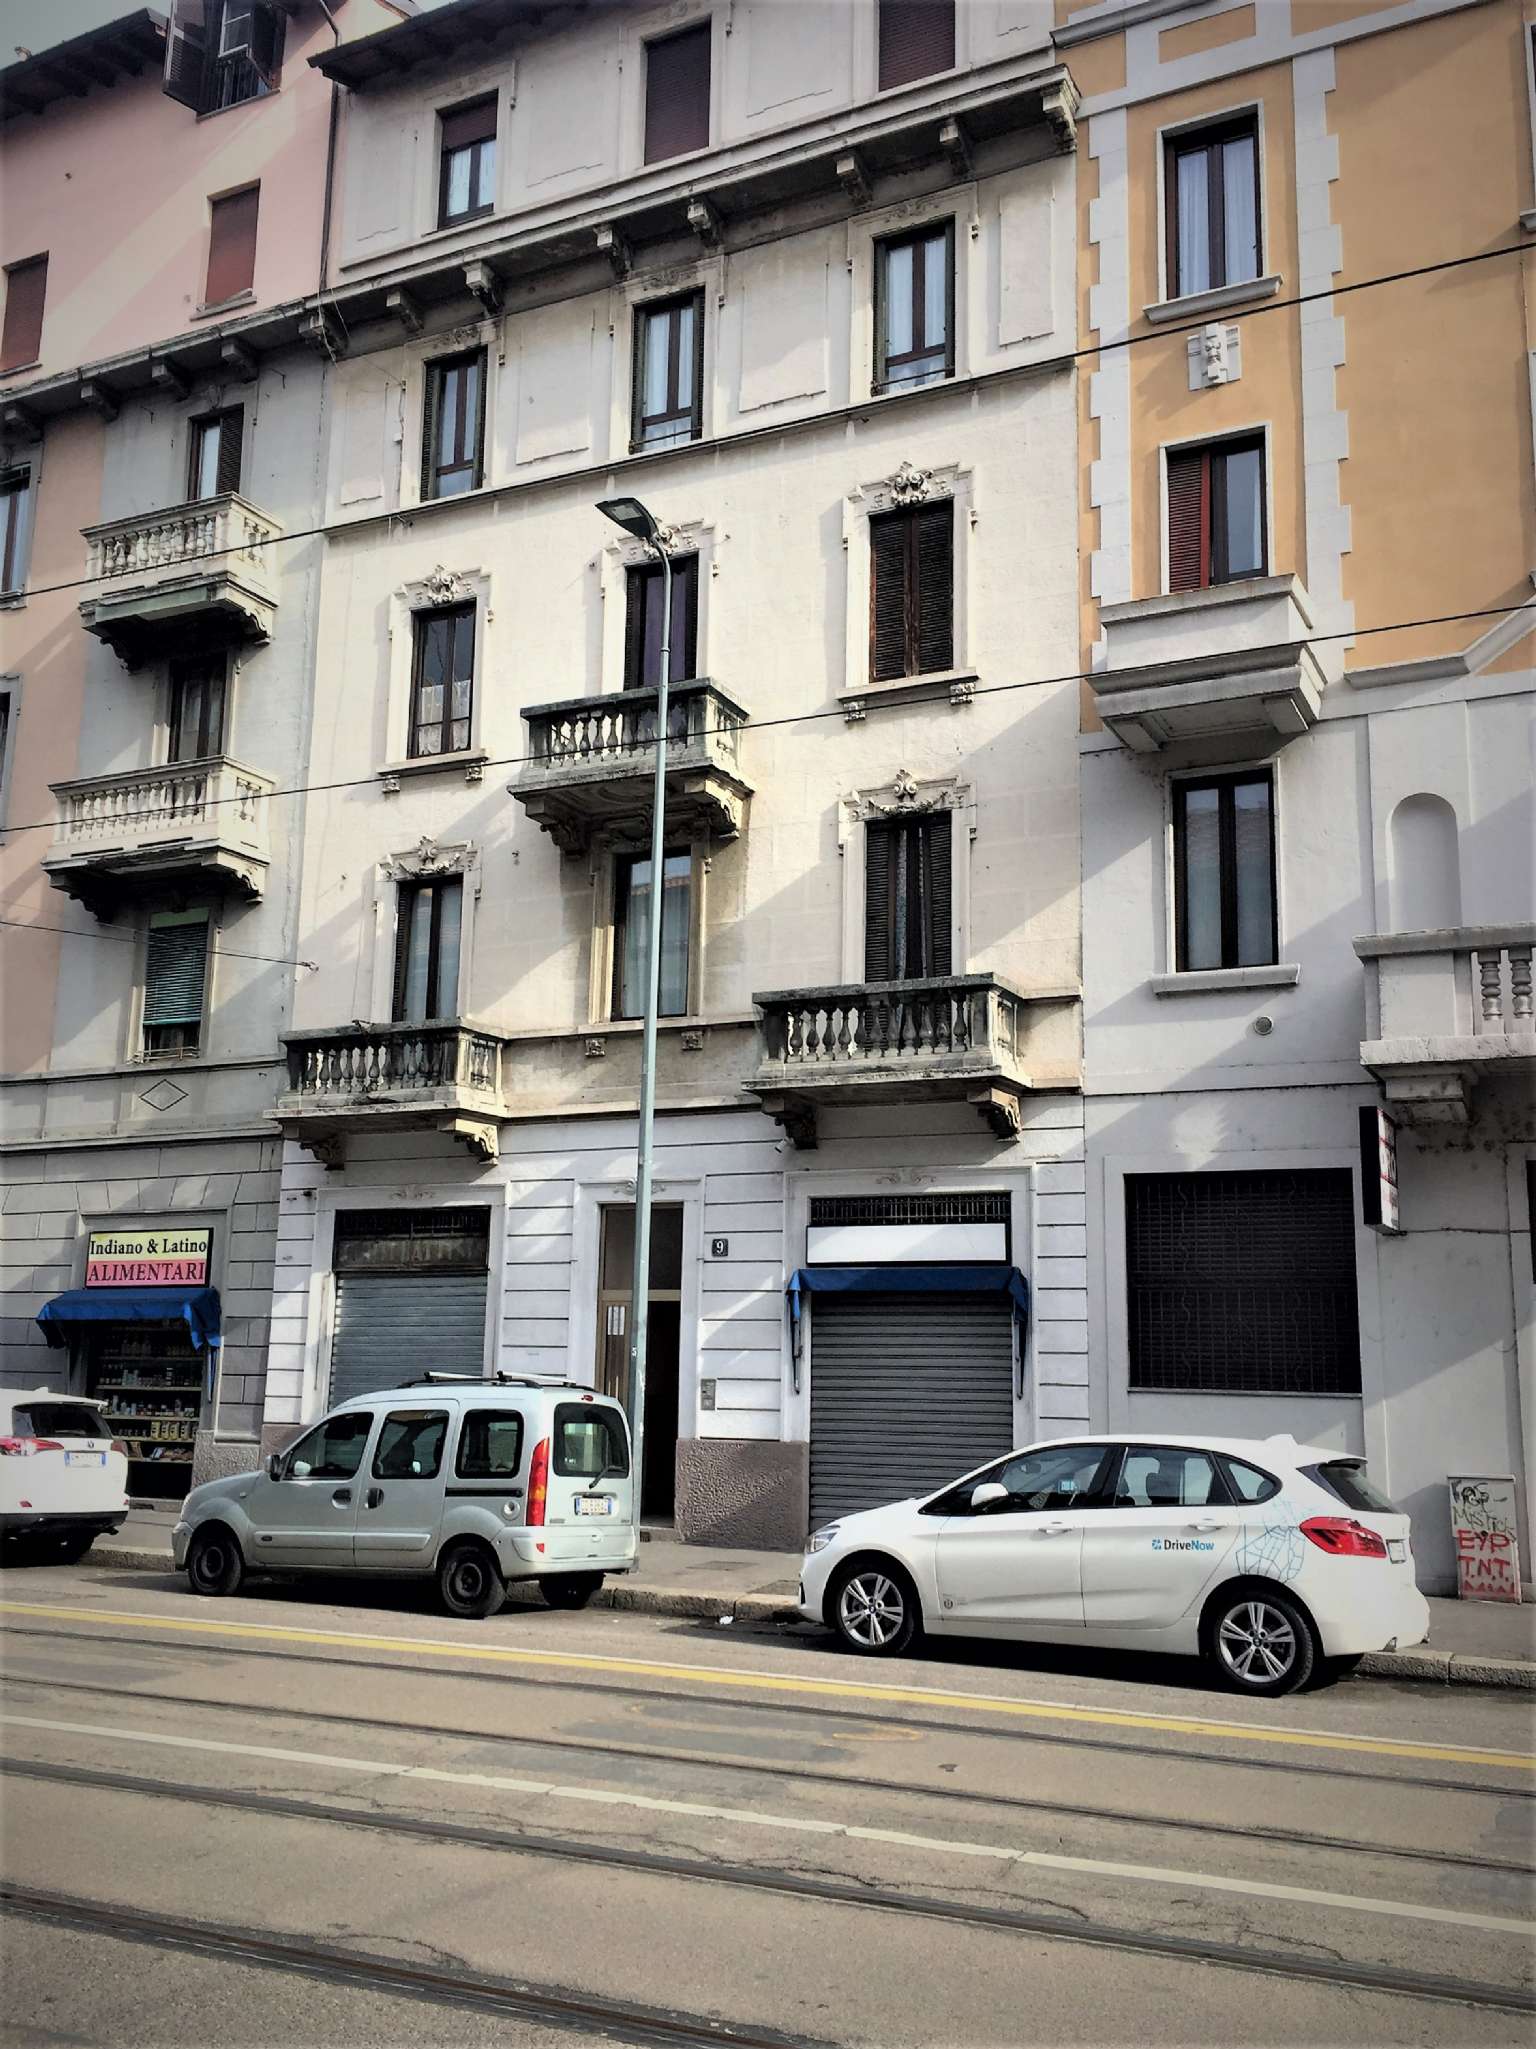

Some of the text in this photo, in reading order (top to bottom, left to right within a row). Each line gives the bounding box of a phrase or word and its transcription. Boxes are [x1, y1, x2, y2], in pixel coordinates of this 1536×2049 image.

[90, 1237, 207, 1255] Indiano & Latino
[716, 1240, 724, 1253] 9
[88, 1262, 205, 1281] ALIMENTARI
[1163, 1538, 1215, 1551] DriveNow
